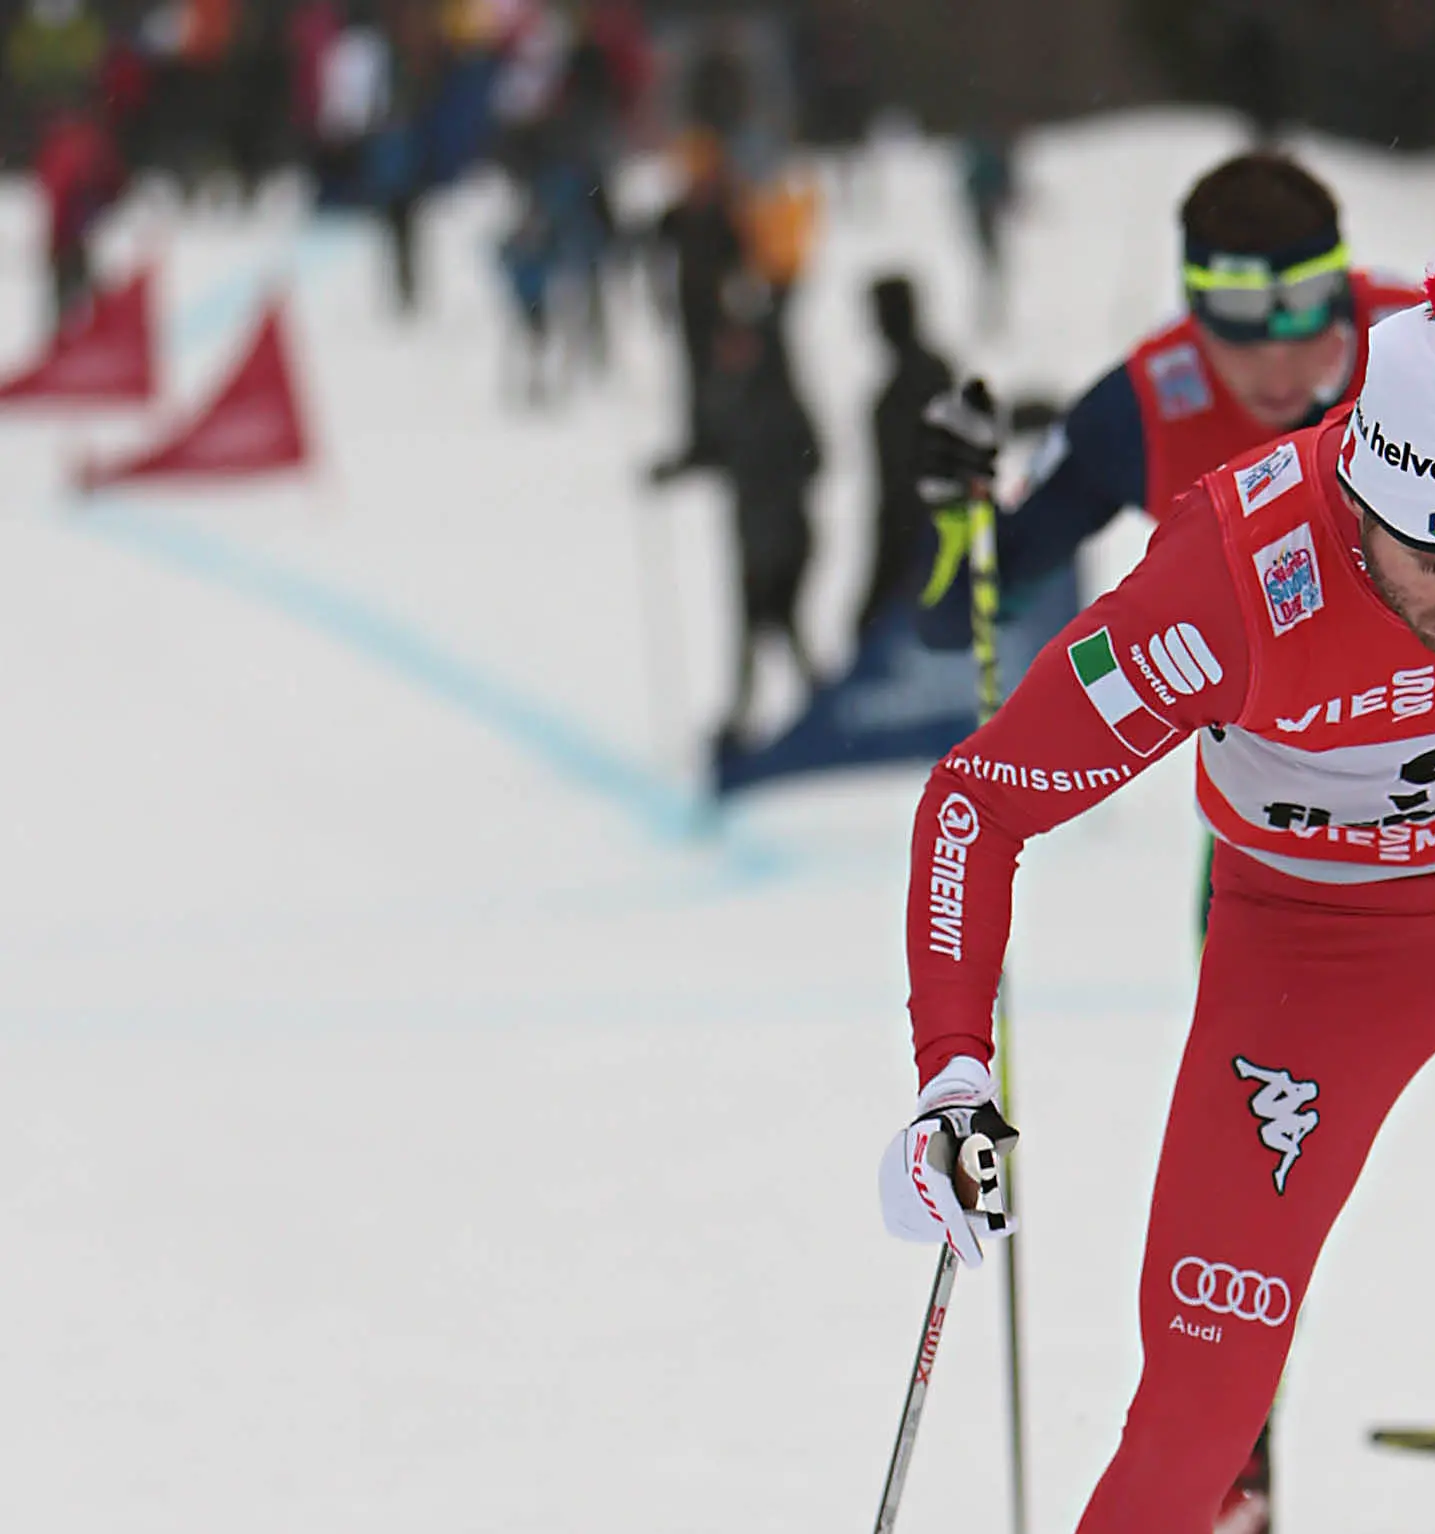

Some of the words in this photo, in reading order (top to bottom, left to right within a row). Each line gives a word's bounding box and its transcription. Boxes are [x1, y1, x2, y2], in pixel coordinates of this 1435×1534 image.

[1129, 643, 1177, 707] sportful
[943, 755, 1133, 792] intimissimi
[928, 837, 968, 962] ENERVIT
[1168, 1313, 1223, 1344] Audi
